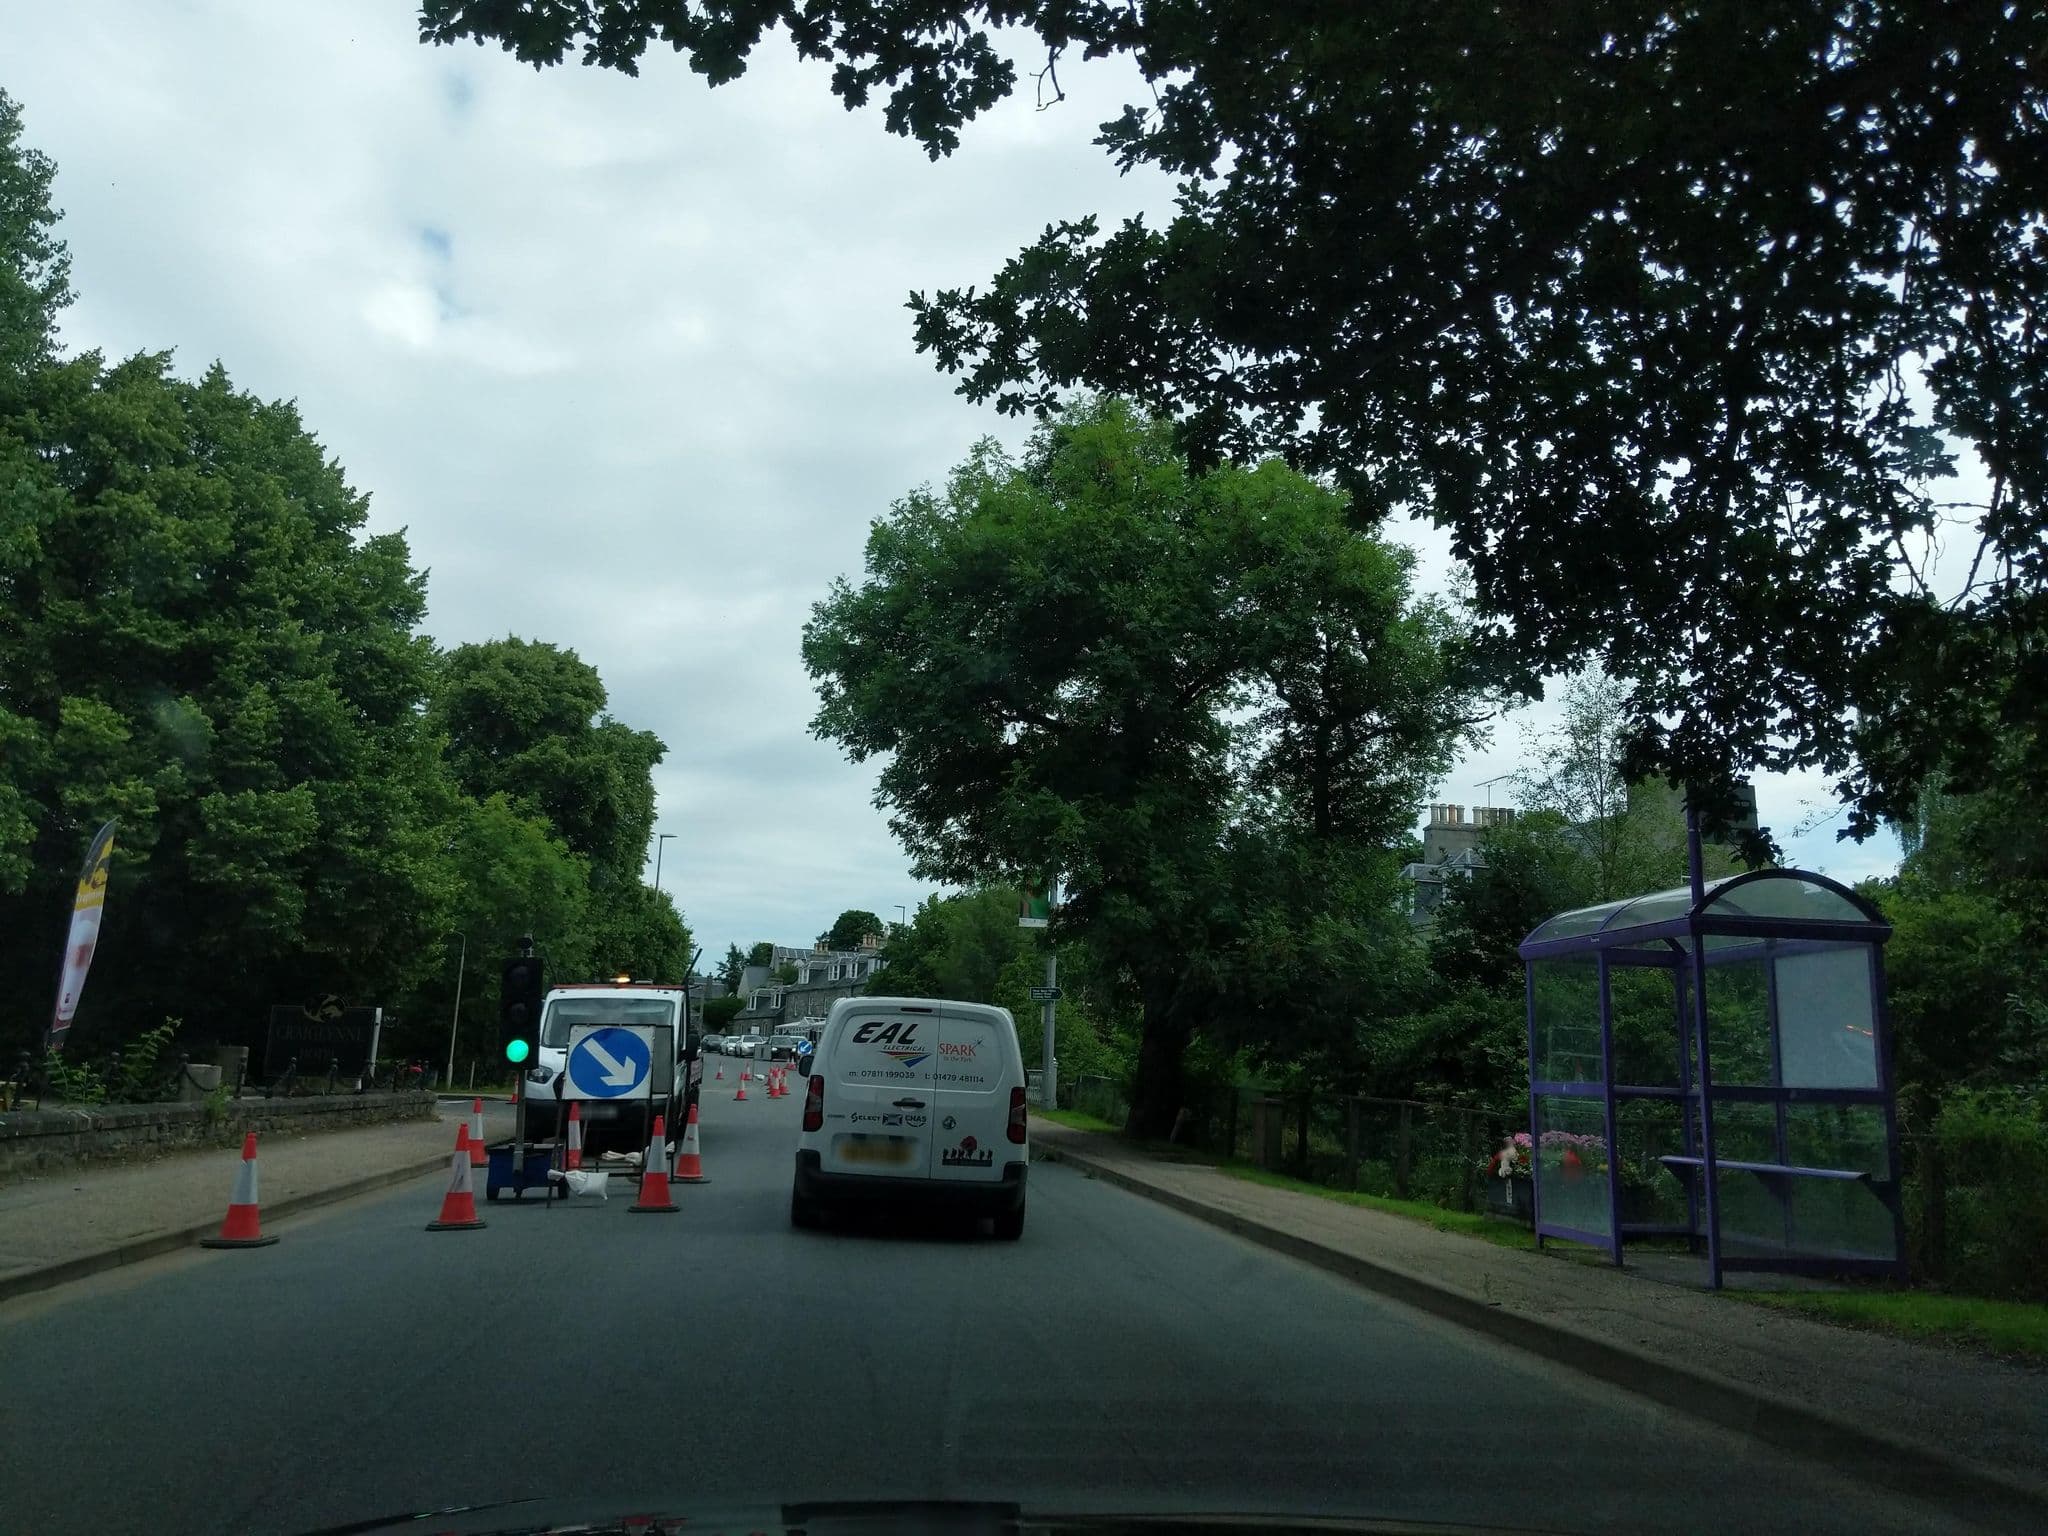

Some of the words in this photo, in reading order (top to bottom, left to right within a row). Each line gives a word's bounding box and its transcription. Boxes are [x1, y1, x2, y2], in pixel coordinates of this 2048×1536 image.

[853, 1022, 918, 1044] EAL
[938, 1042, 976, 1056] SPARK
[885, 1071, 915, 1079] 199039
[933, 1073, 956, 1081] 01479
[959, 1075, 984, 1083] 481114
